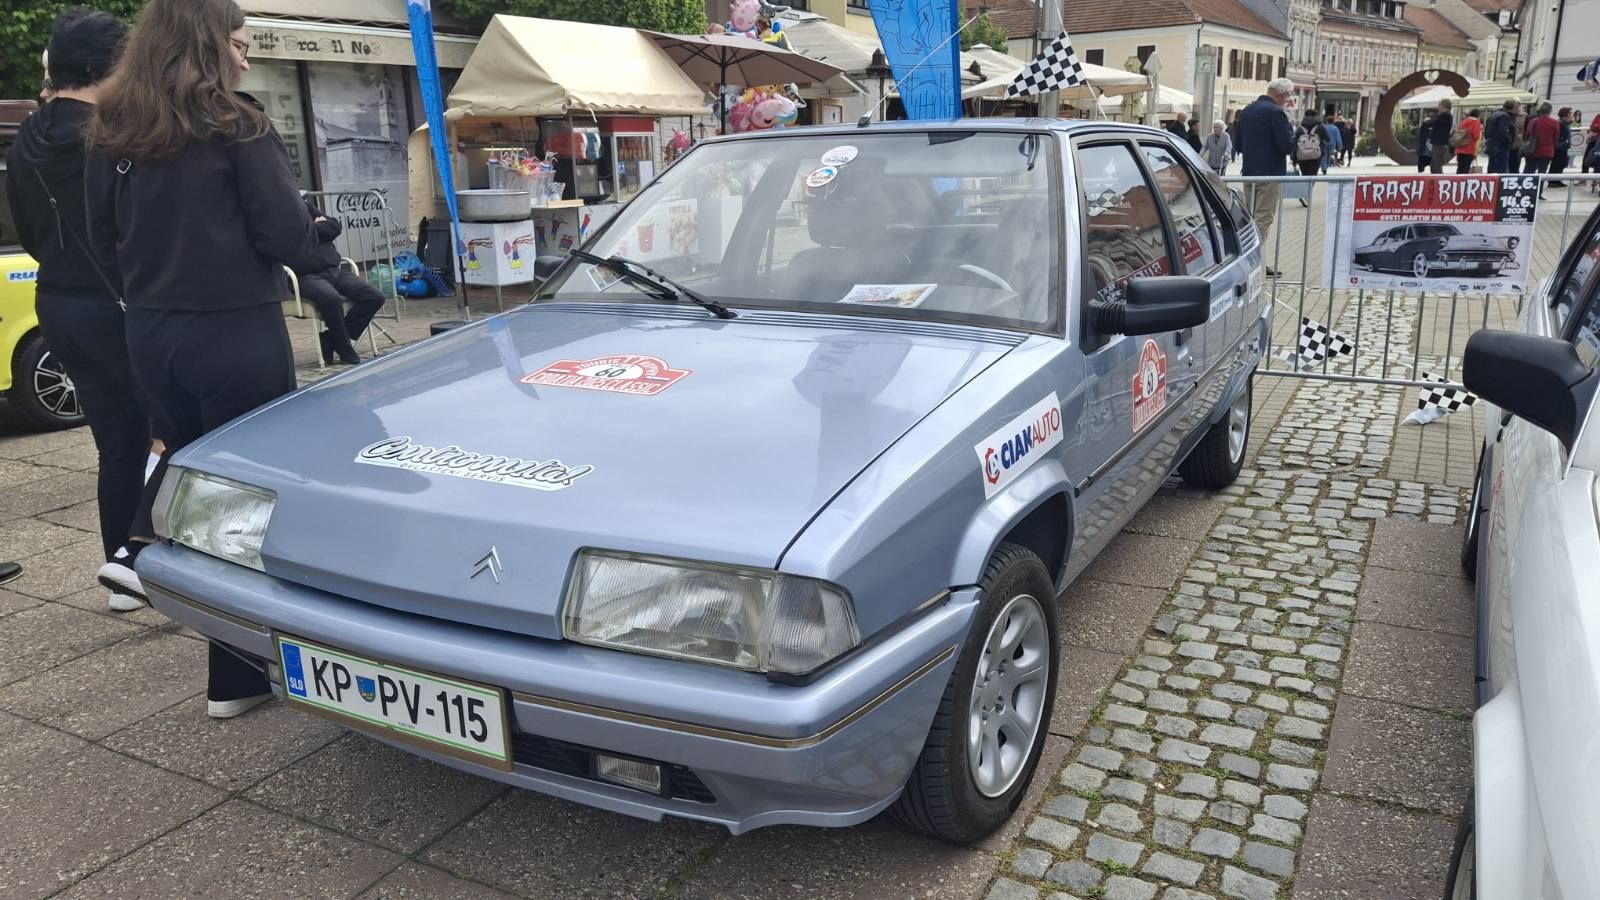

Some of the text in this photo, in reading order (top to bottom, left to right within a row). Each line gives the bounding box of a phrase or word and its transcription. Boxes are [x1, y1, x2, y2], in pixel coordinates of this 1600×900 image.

[259, 41, 275, 50] bar
[1501, 176, 1538, 190] 13.6.
[1358, 180, 1425, 206] TRASH
[1438, 178, 1495, 206] BURN
[1500, 195, 1535, 208] 14.6.
[346, 216, 382, 229] kava
[594, 367, 627, 378] 60
[290, 676, 304, 691] SLO
[311, 656, 488, 743] KP PV-115
